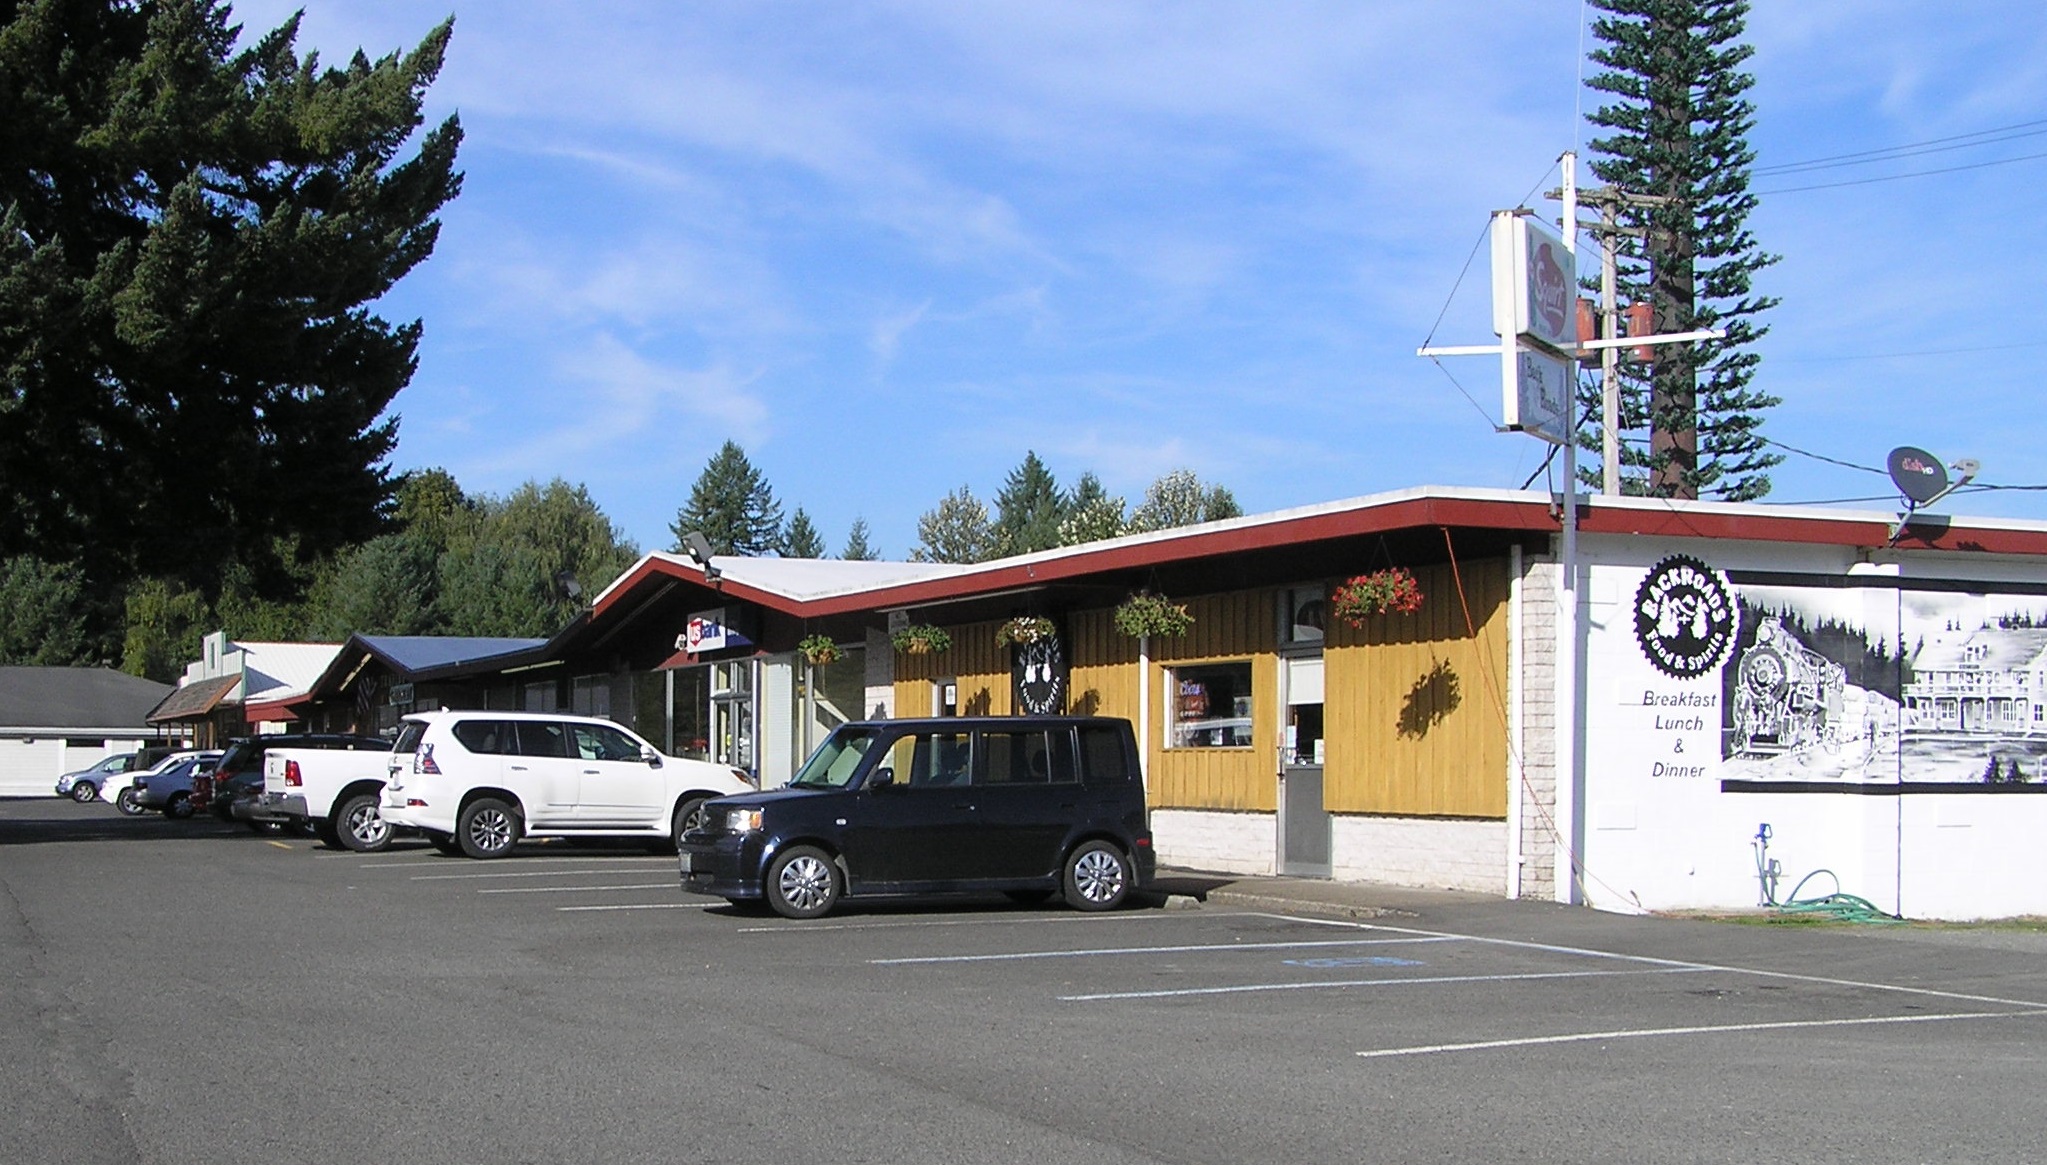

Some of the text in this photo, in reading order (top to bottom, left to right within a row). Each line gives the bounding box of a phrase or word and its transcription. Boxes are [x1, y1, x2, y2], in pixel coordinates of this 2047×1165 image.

[1641, 565, 1727, 623] BACKROADS
[1645, 628, 1724, 671] Food & Spirits
[1643, 690, 1717, 707] Breakfast
[1655, 714, 1704, 731] Lunch
[1673, 738, 1684, 754] &
[1652, 761, 1706, 778] Dinner
